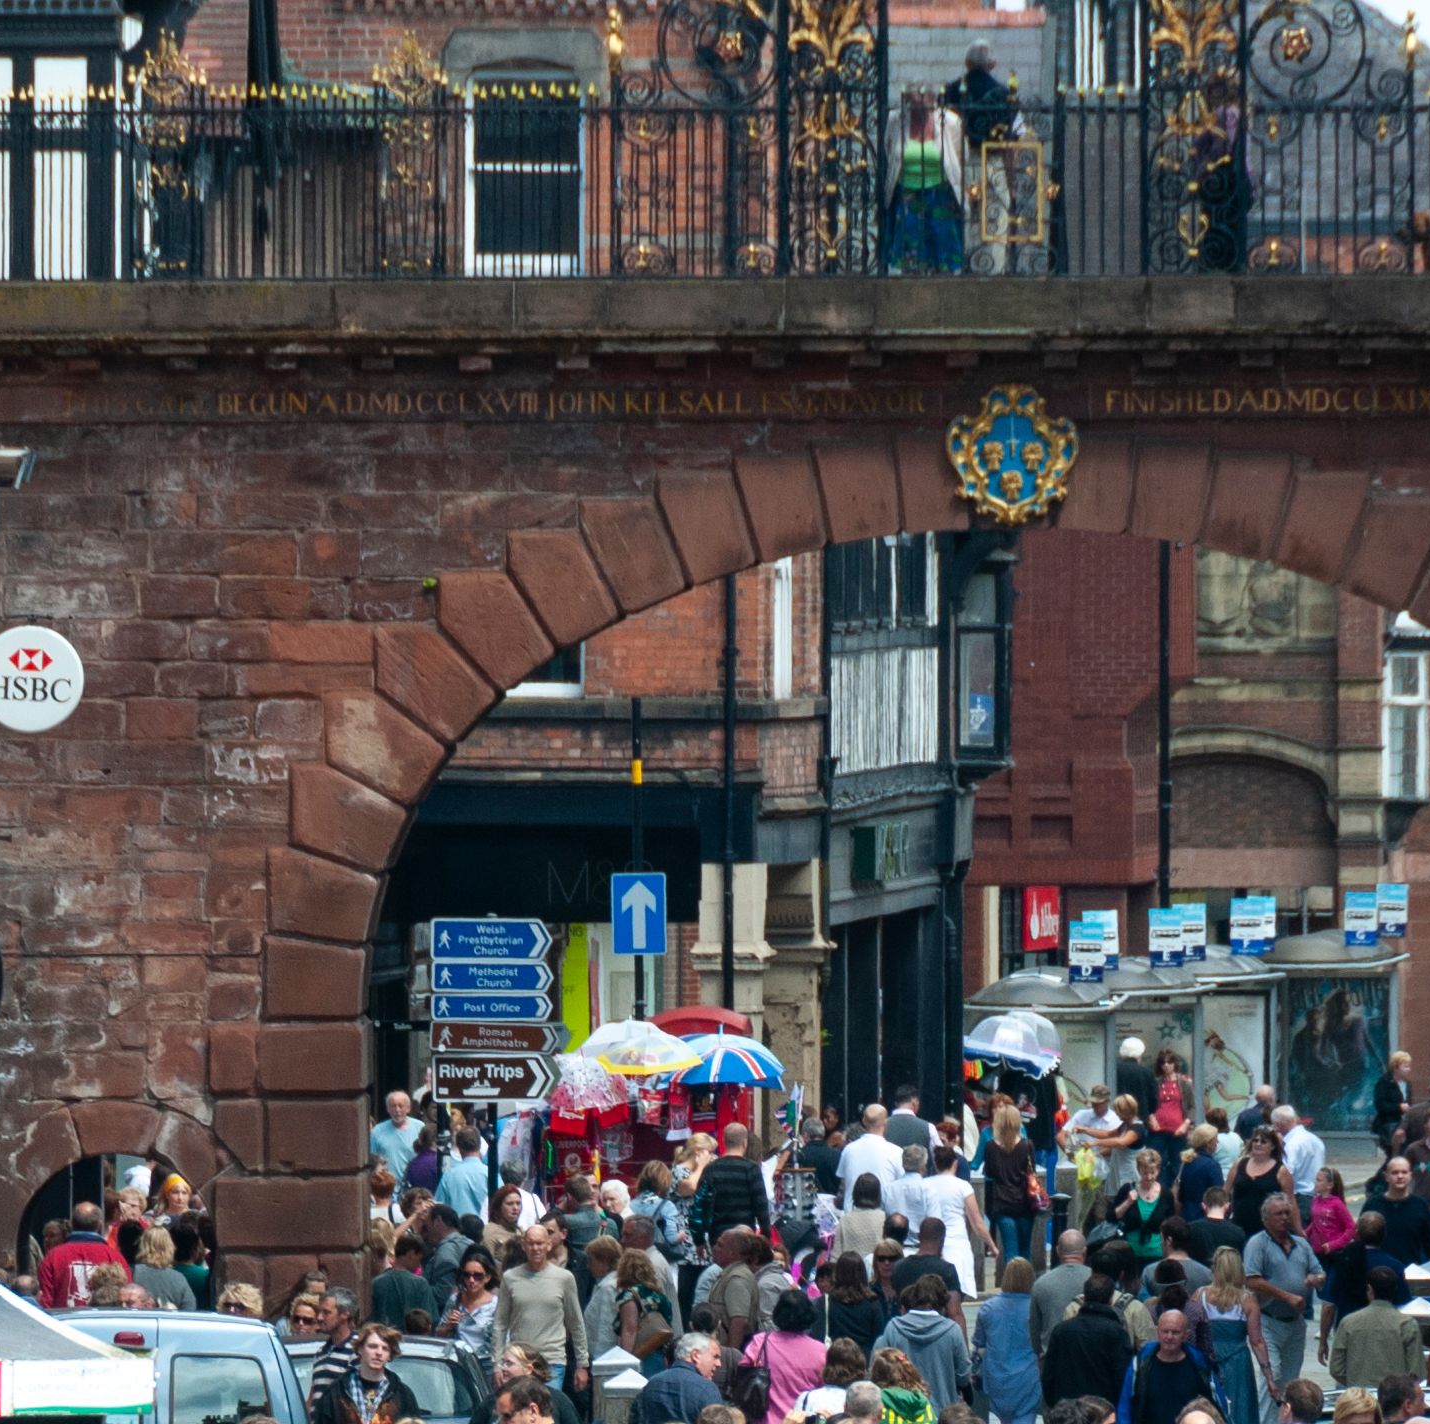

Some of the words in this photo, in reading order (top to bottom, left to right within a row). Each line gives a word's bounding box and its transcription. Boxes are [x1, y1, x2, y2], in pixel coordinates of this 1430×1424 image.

[219, 390, 307, 416] BEGUN
[546, 390, 614, 420] JOHN
[1105, 387, 1231, 413] FINISHED
[475, 925, 506, 934] Welsh
[458, 936, 524, 946] Presbyterian
[473, 946, 509, 956] Church
[468, 967, 519, 977] Methodist
[1081, 965, 1092, 976] D
[476, 979, 512, 989] Church
[463, 1003, 486, 1013] Post
[490, 1003, 521, 1013] Office
[478, 1027, 513, 1037] Roman
[461, 1037, 529, 1048] Amphitheatre
[438, 1064, 481, 1079] River
[484, 1064, 525, 1082] Trips
